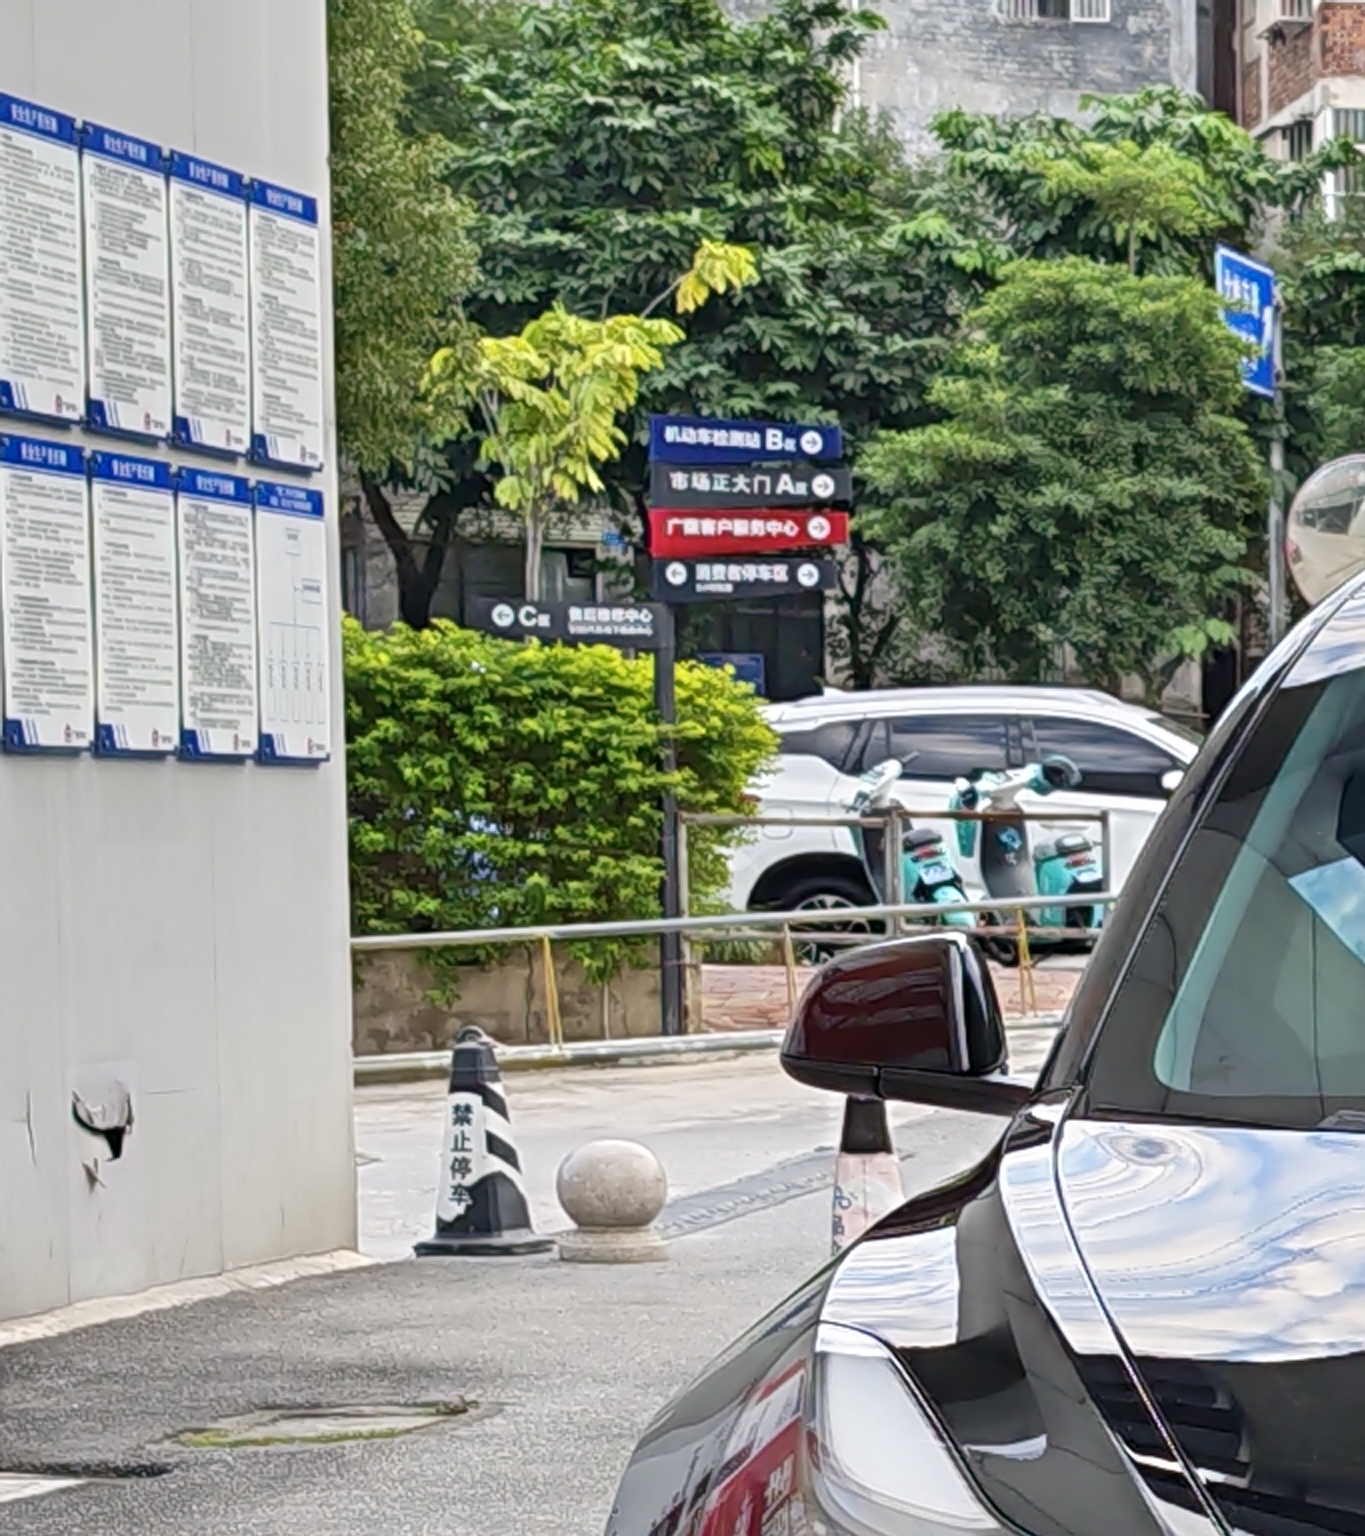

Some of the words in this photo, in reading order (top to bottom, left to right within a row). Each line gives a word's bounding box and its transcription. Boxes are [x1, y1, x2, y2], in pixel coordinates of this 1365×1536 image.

[669, 472, 771, 494] 市场正大门
